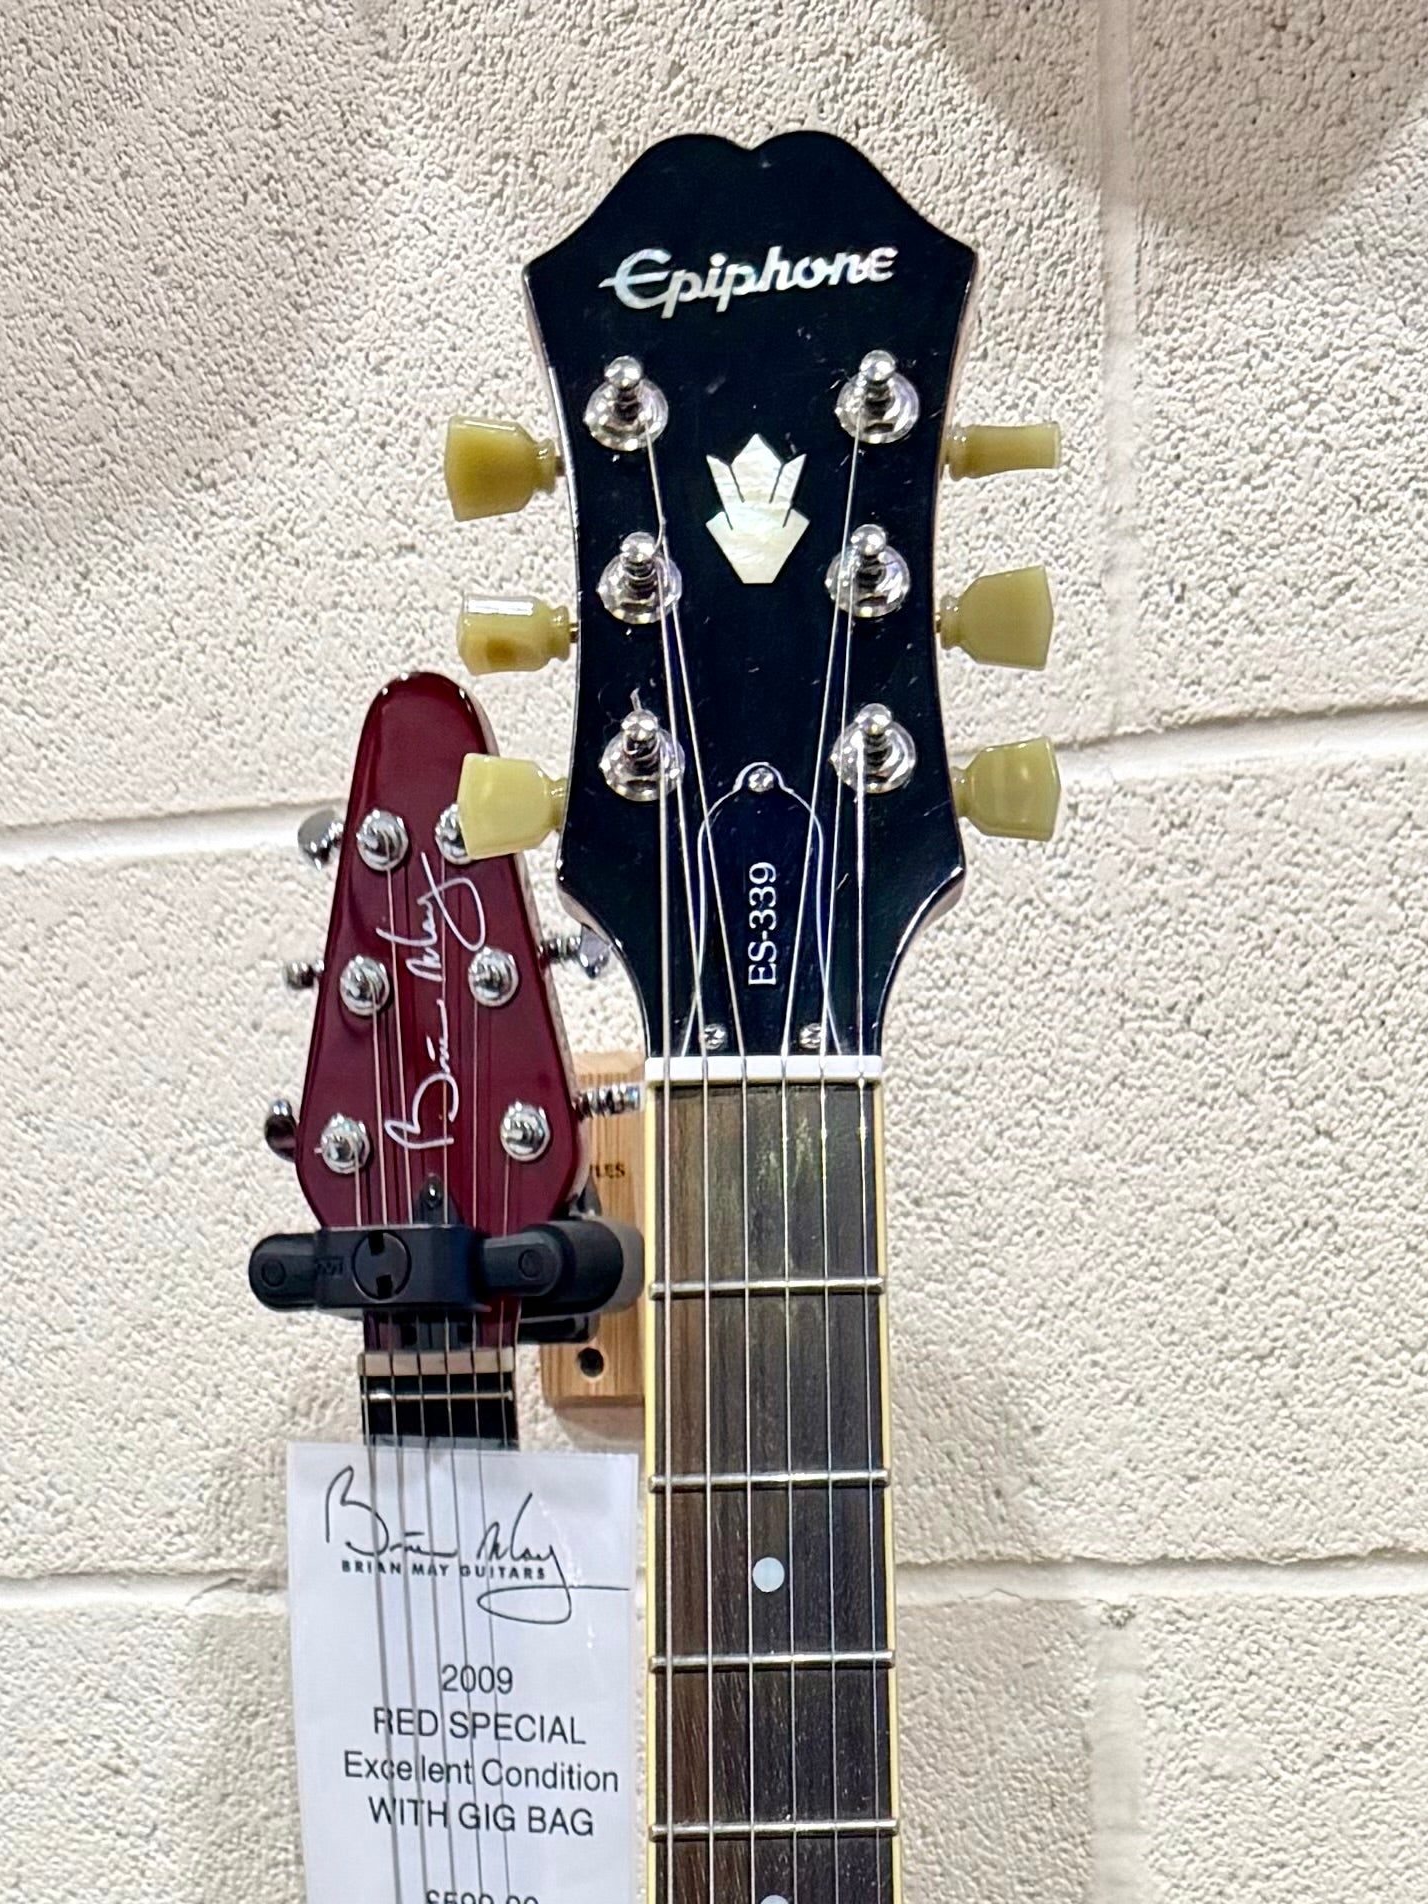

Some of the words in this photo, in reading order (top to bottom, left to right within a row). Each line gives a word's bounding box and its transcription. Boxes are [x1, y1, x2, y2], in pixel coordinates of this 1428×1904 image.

[598, 246, 899, 319] Epiphone
[747, 862, 778, 986] ES-339
[341, 1560, 401, 1576] BRIAN
[411, 1562, 450, 1577] MAY
[459, 1564, 546, 1581] GUITARS
[441, 1664, 514, 1695] 2009
[373, 1706, 439, 1737] RED
[449, 1710, 586, 1746] SPECIAL
[344, 1750, 473, 1786] Excelent
[481, 1757, 619, 1793] Condition
[368, 1796, 448, 1829] WITH
[458, 1802, 516, 1832] GIG
[527, 1806, 594, 1837] BAG
